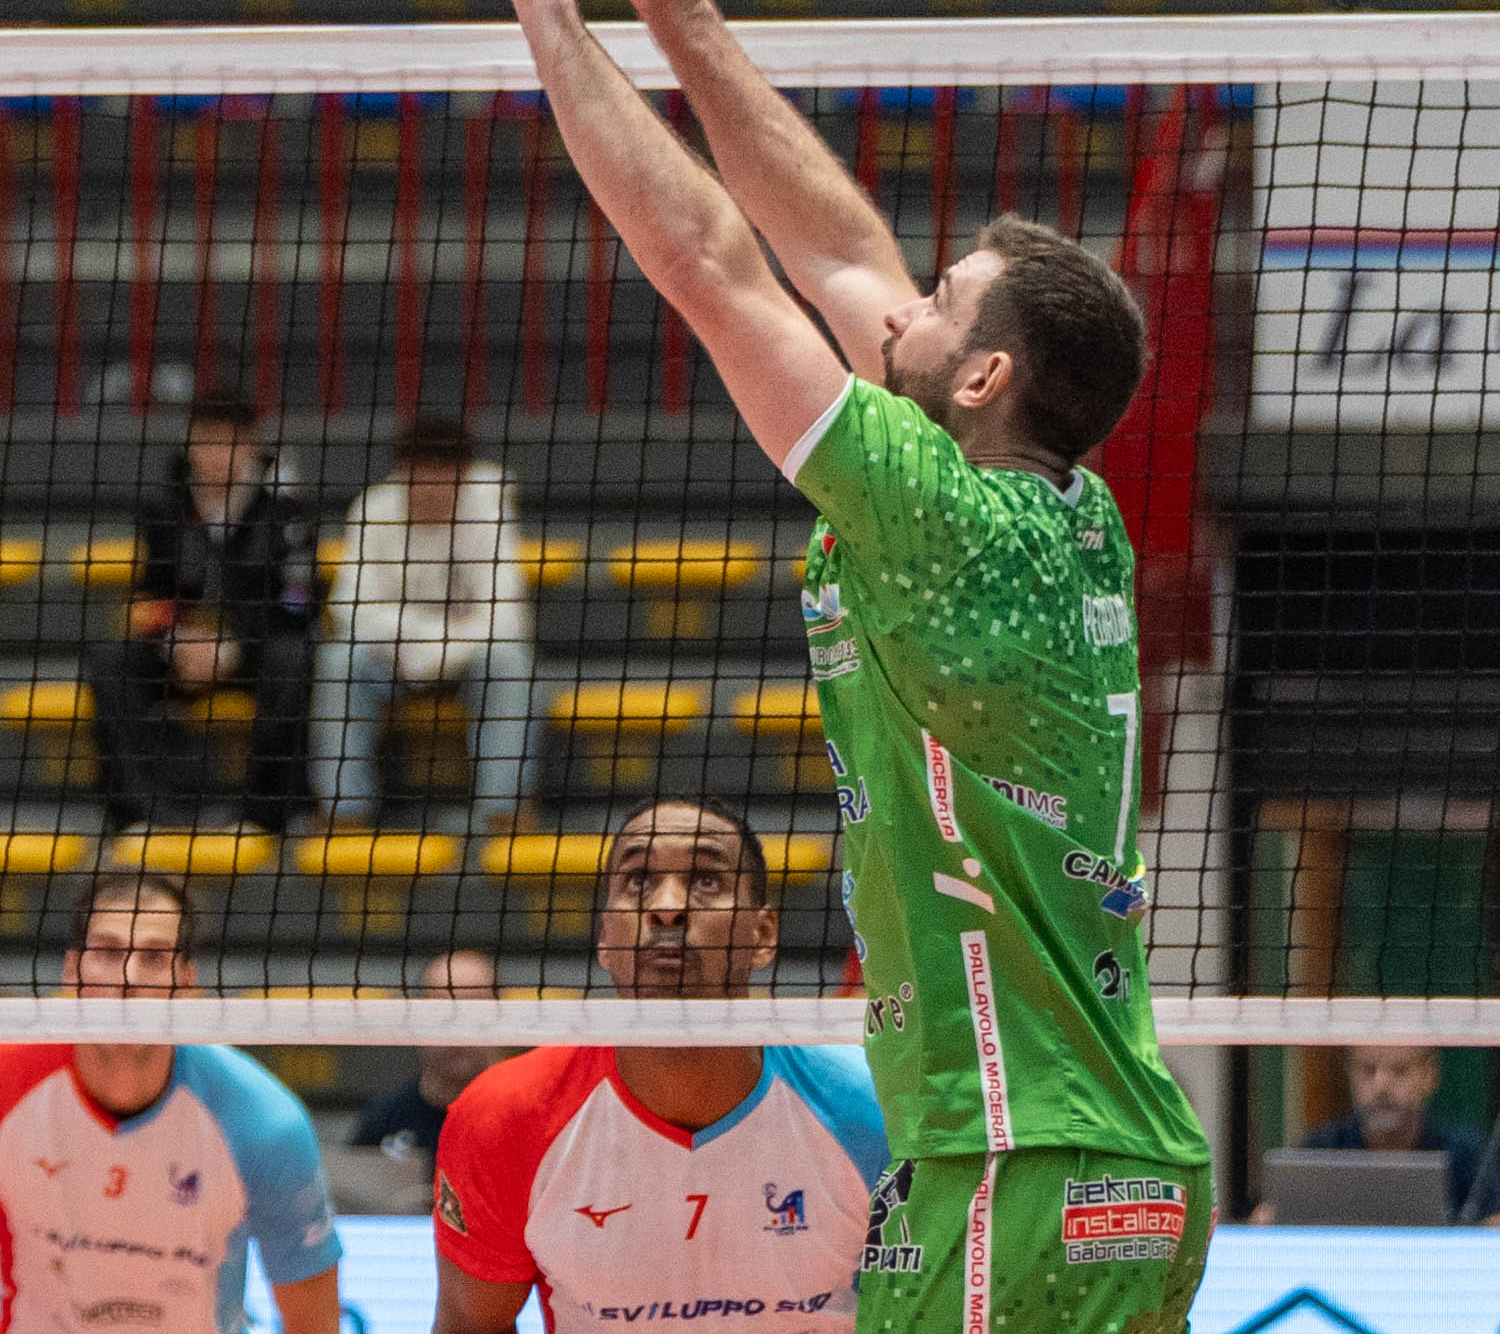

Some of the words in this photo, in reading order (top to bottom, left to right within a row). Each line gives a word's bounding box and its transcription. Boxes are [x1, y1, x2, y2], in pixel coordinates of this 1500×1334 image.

[1312, 271, 1458, 373] La
[967, 942, 998, 1058] PALLAVOLO
[1067, 1174, 1161, 1206] tekno
[684, 1194, 709, 1240] 7
[599, 1298, 766, 1322] SVILUPPO
